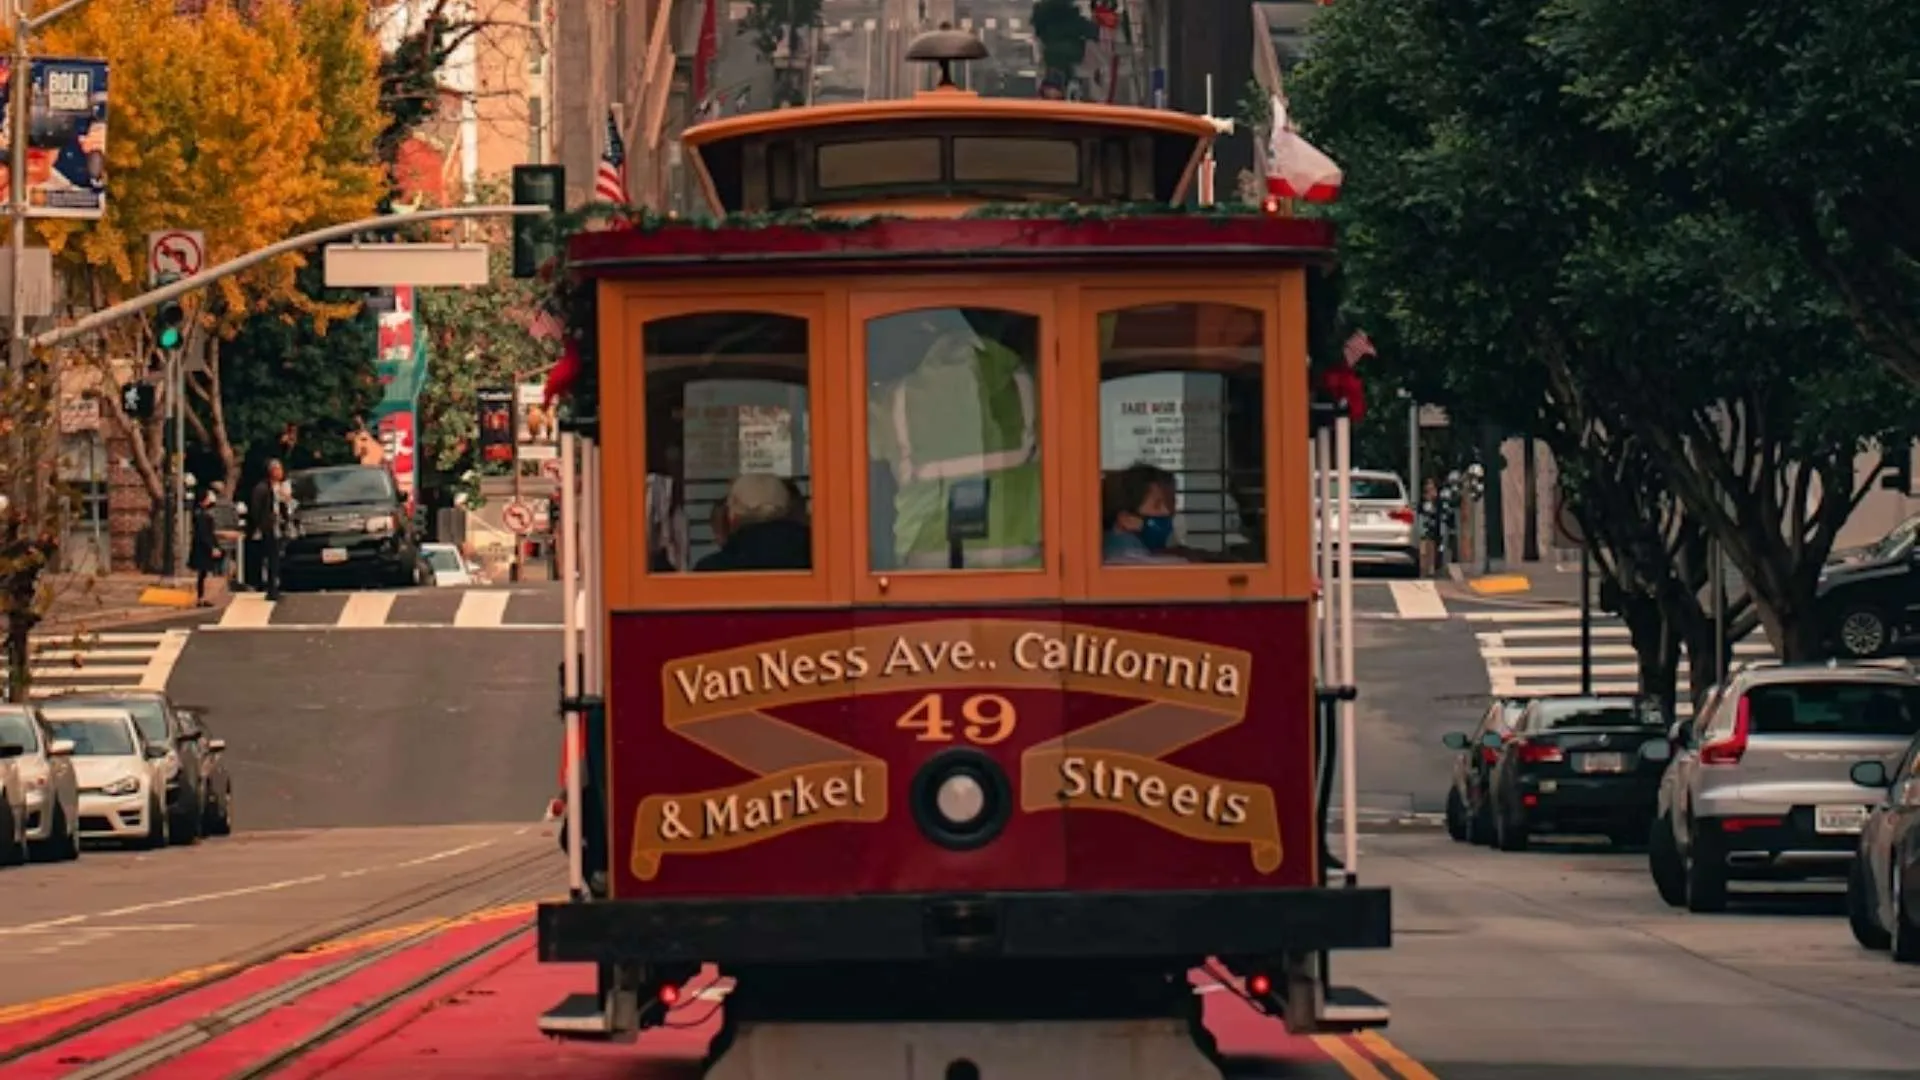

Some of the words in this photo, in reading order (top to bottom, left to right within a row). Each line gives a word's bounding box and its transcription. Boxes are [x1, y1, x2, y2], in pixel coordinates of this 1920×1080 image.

[674, 664, 754, 705] Van
[757, 647, 869, 690] Ness
[1013, 631, 1240, 697] California
[896, 693, 1017, 745] 49
[659, 800, 693, 840] &
[701, 766, 866, 839] Market
[1060, 756, 1250, 828] Streets
